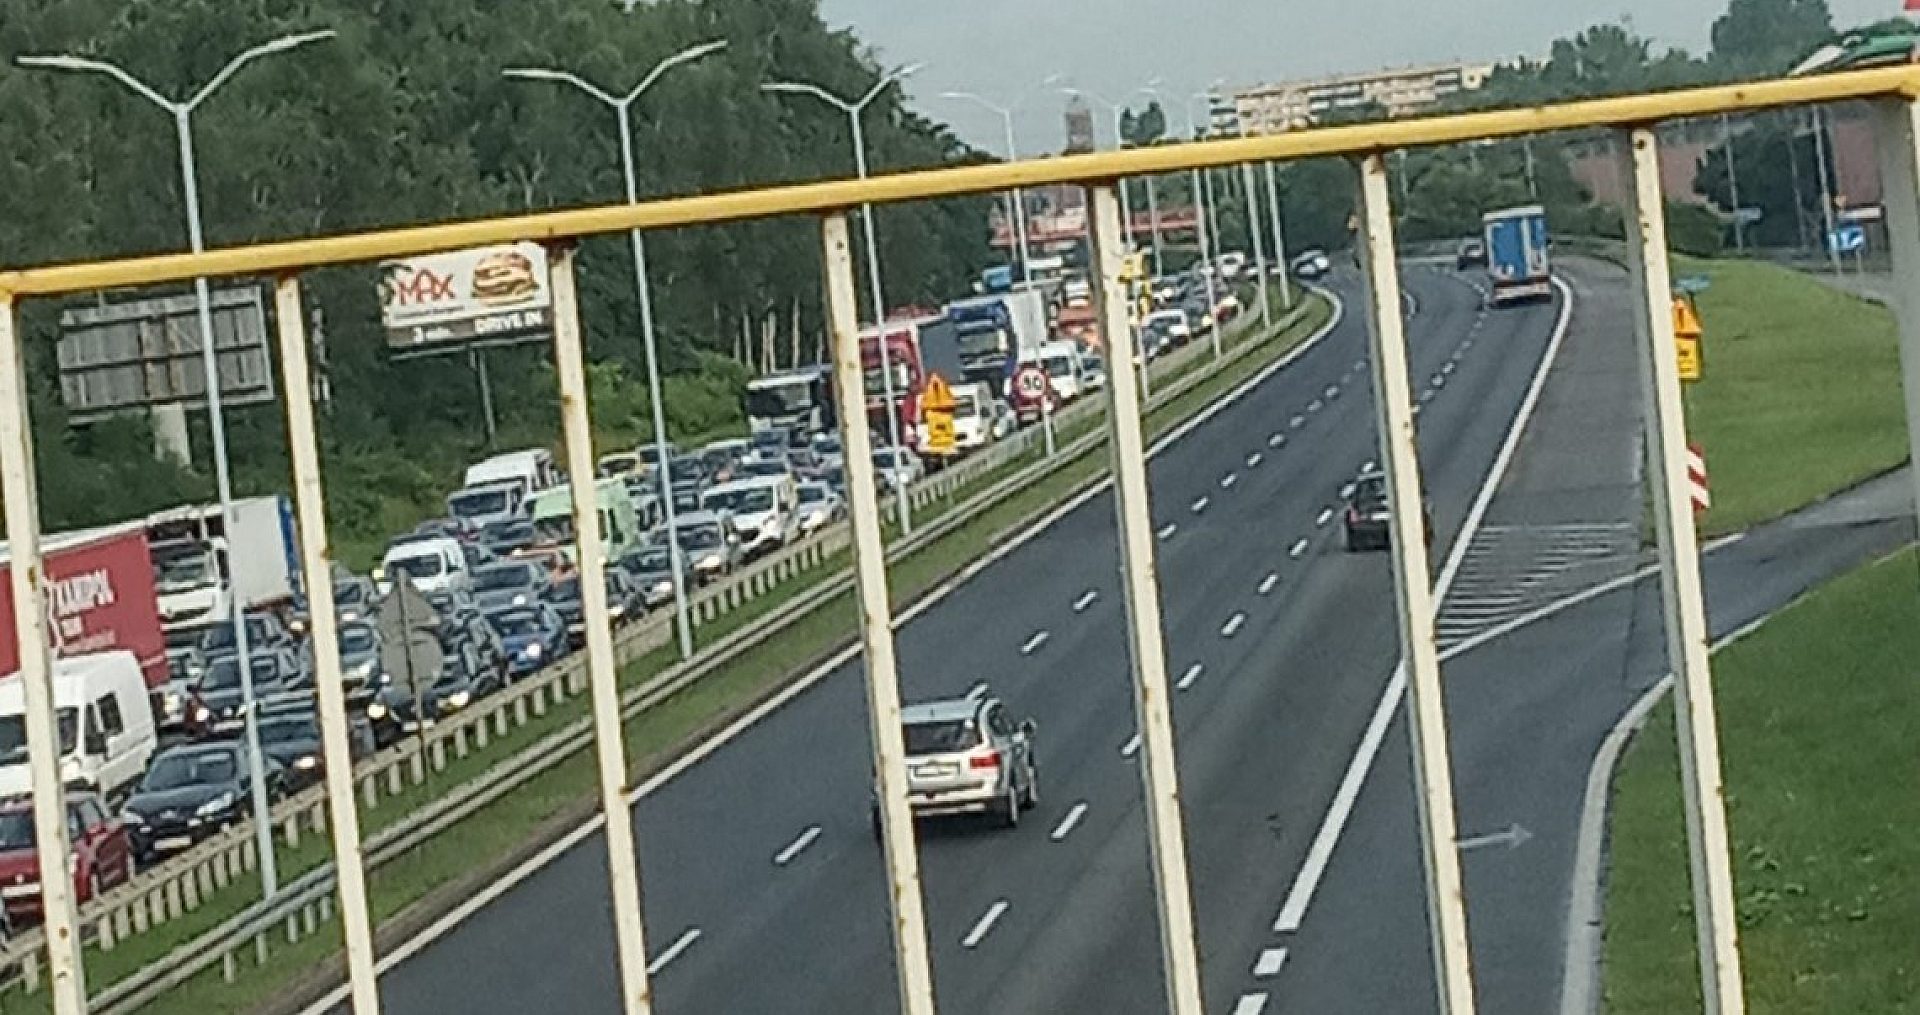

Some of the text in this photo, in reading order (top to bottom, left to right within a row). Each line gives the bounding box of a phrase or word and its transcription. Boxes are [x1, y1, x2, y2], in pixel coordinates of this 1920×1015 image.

[397, 268, 456, 306] MAX
[474, 309, 543, 334] DRIVE IN
